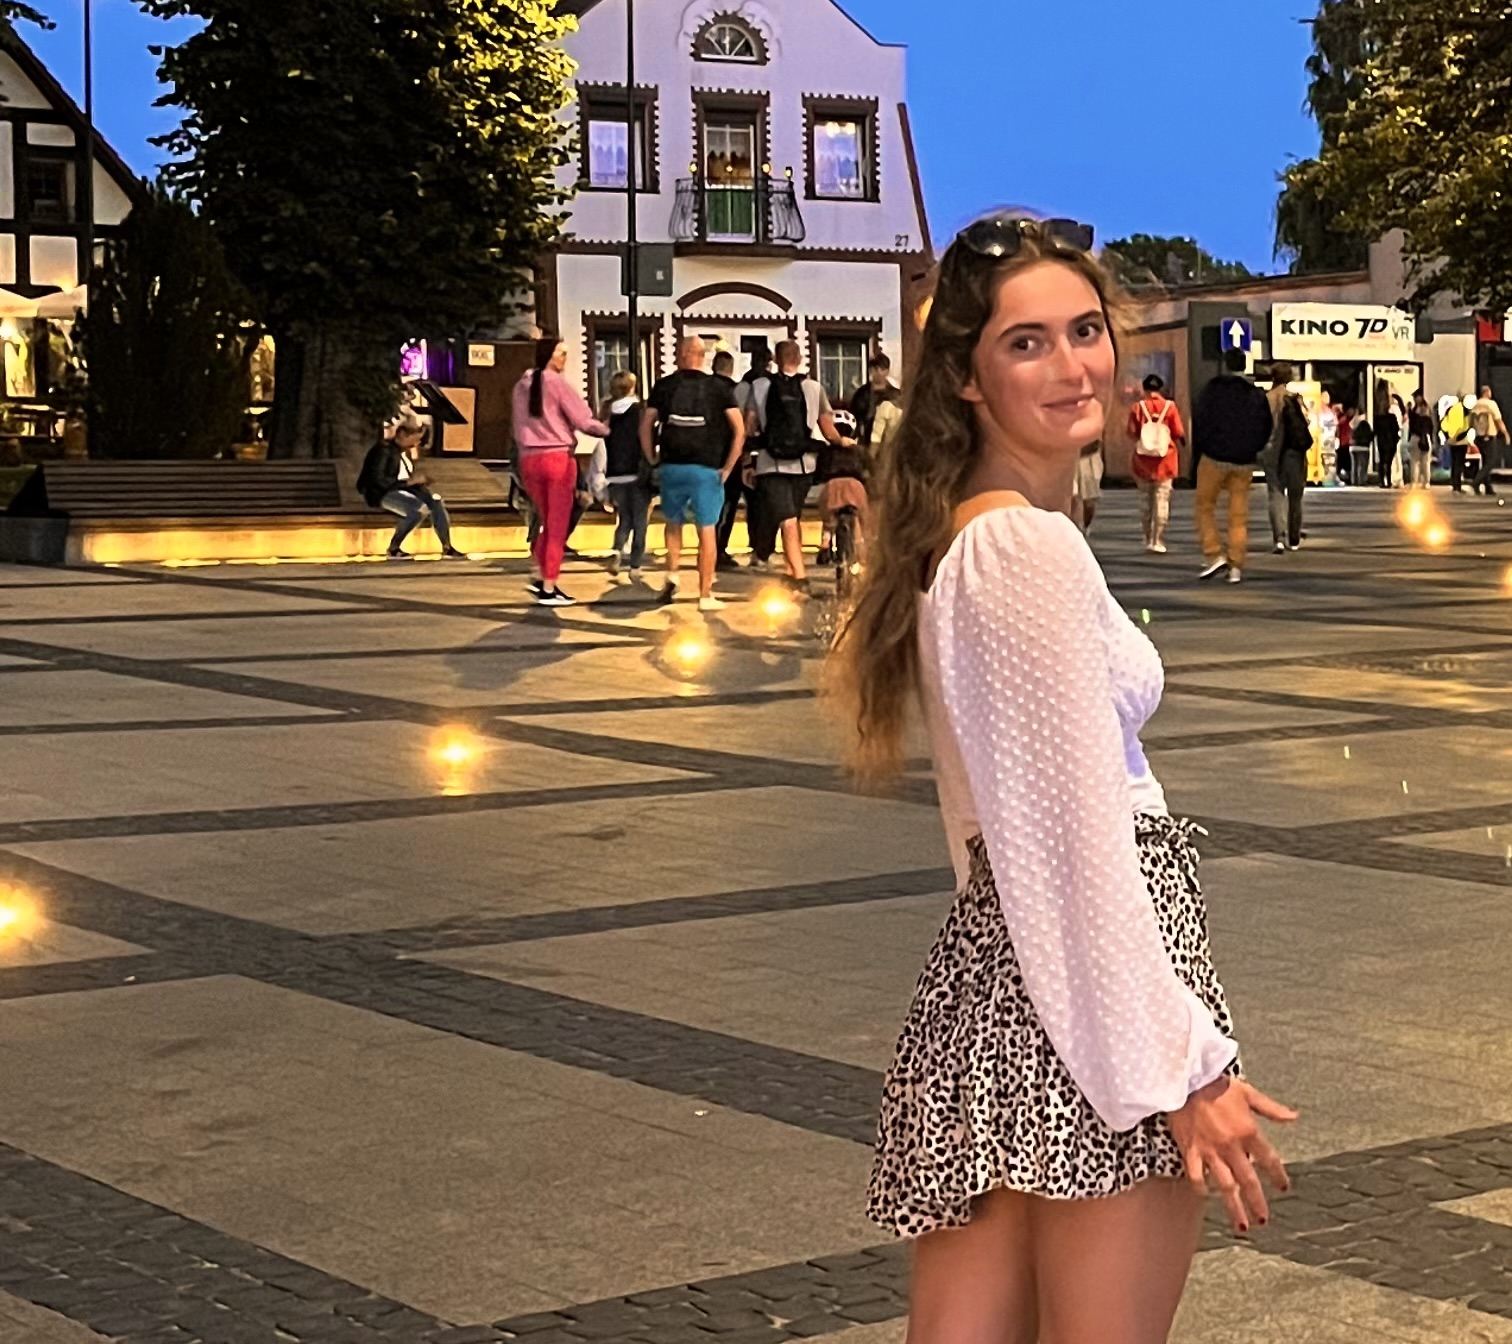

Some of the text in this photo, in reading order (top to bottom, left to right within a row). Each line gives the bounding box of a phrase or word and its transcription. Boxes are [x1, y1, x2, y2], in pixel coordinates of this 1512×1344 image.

[894, 233, 909, 247] 27
[1280, 318, 1350, 337] KINO
[1391, 325, 1411, 341] VR
